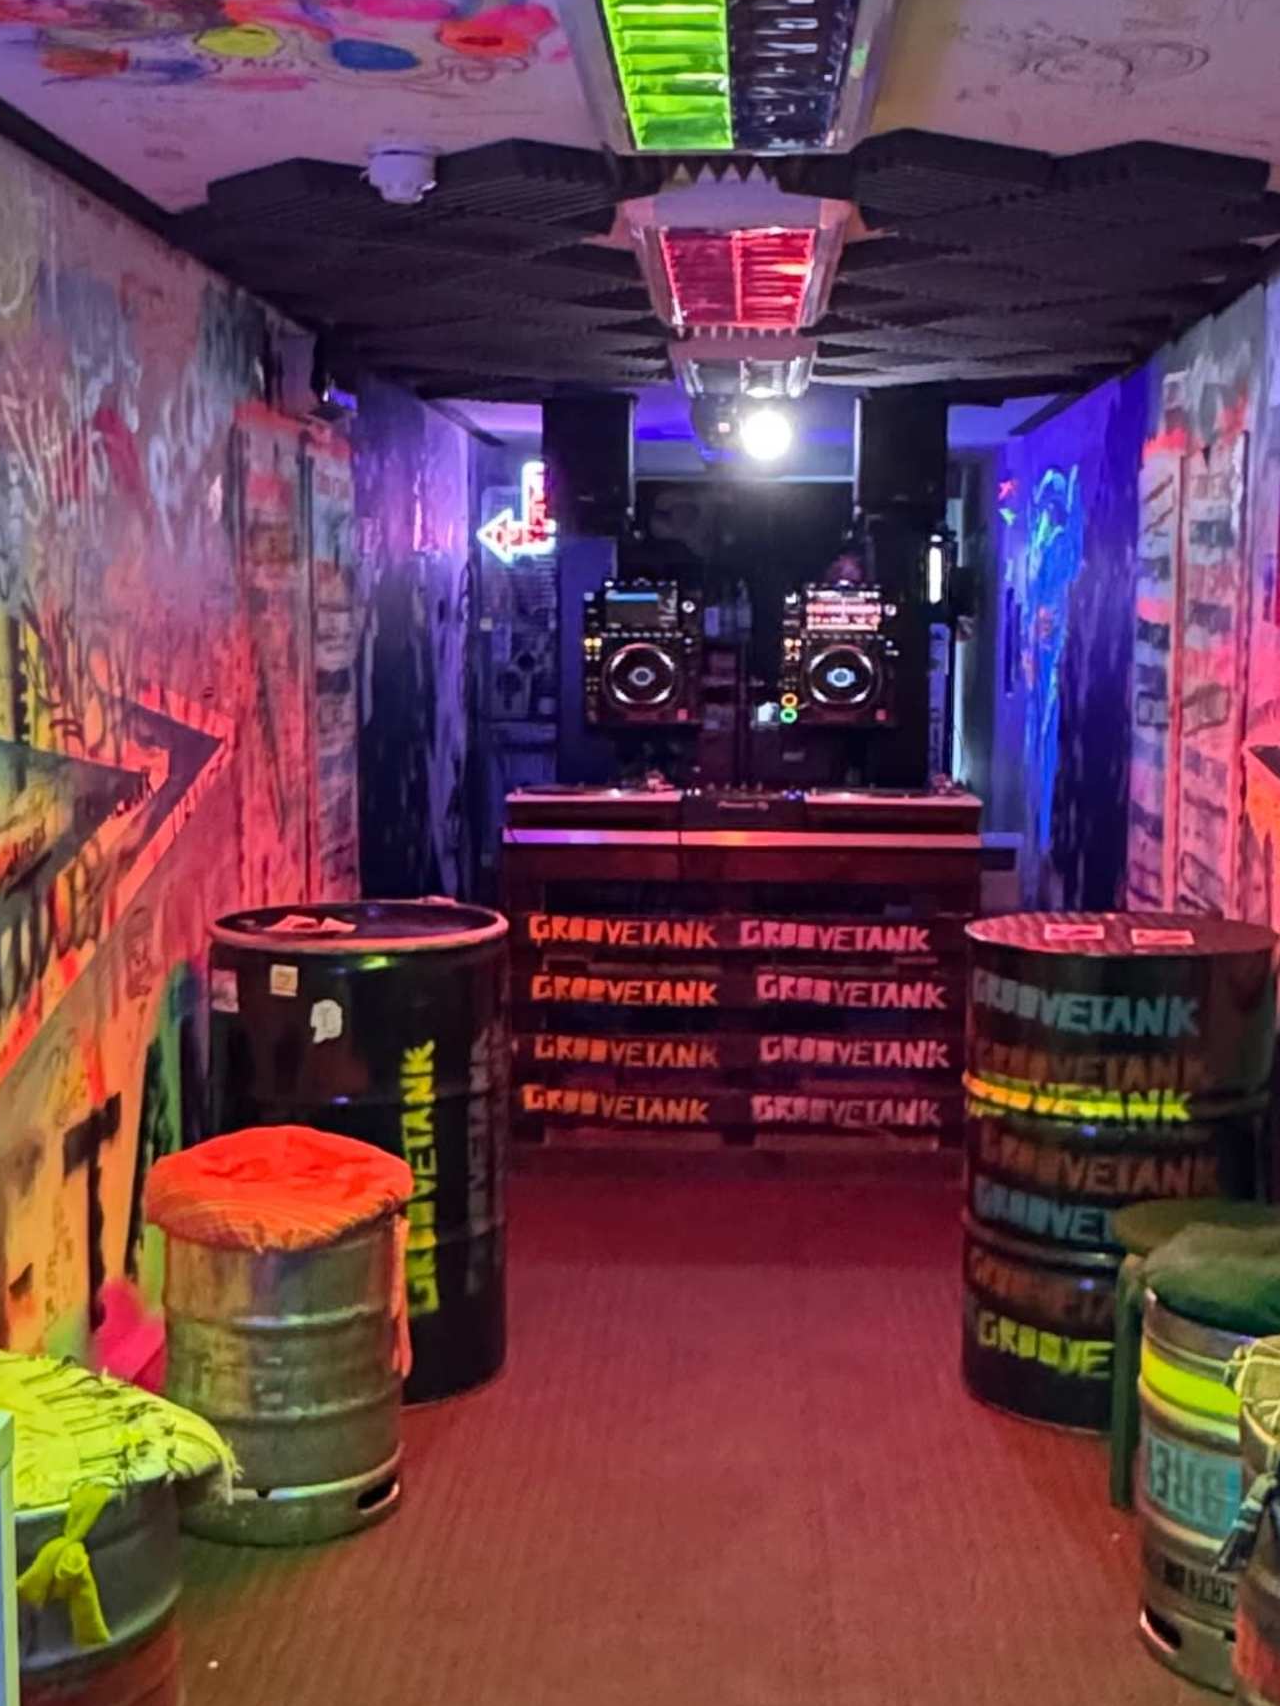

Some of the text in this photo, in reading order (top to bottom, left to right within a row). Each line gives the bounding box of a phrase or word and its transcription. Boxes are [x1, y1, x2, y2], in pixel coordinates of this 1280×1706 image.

[529, 914, 930, 951] GROOVETANK GROOVETANK
[532, 973, 947, 1010] GROOVETANK GROOVETANK
[972, 966, 1201, 1038] GROOVETANK
[534, 1035, 949, 1069] GROOVETANK GROOVETANK
[522, 1084, 942, 1126] GROOVETANK GROOVETANK
